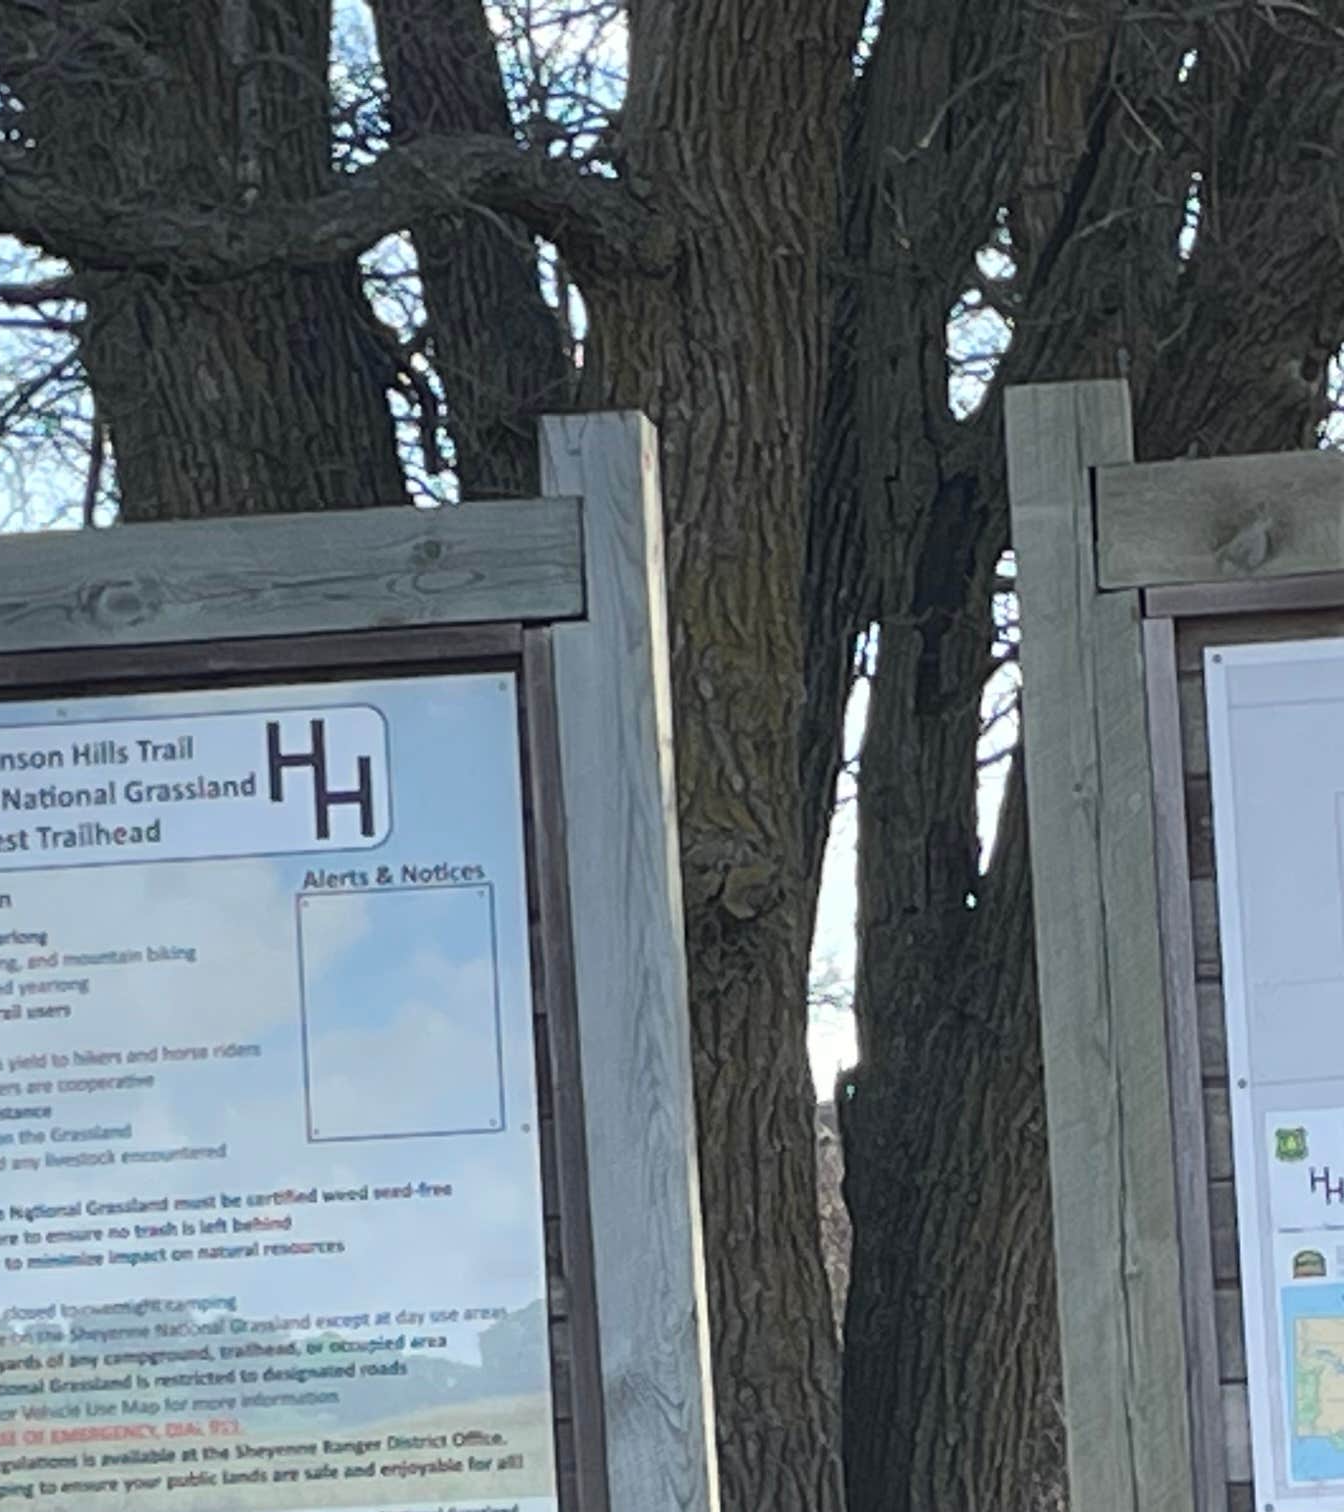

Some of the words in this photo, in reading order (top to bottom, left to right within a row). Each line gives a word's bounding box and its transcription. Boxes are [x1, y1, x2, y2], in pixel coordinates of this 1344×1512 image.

[70, 739, 129, 767] Hills
[136, 735, 194, 763] Trail
[0, 780, 117, 812] National
[122, 771, 257, 804] Grassland
[35, 818, 162, 850] Trailhead
[301, 867, 369, 890] Alerts
[374, 865, 394, 885] &
[399, 860, 485, 884] Notices
